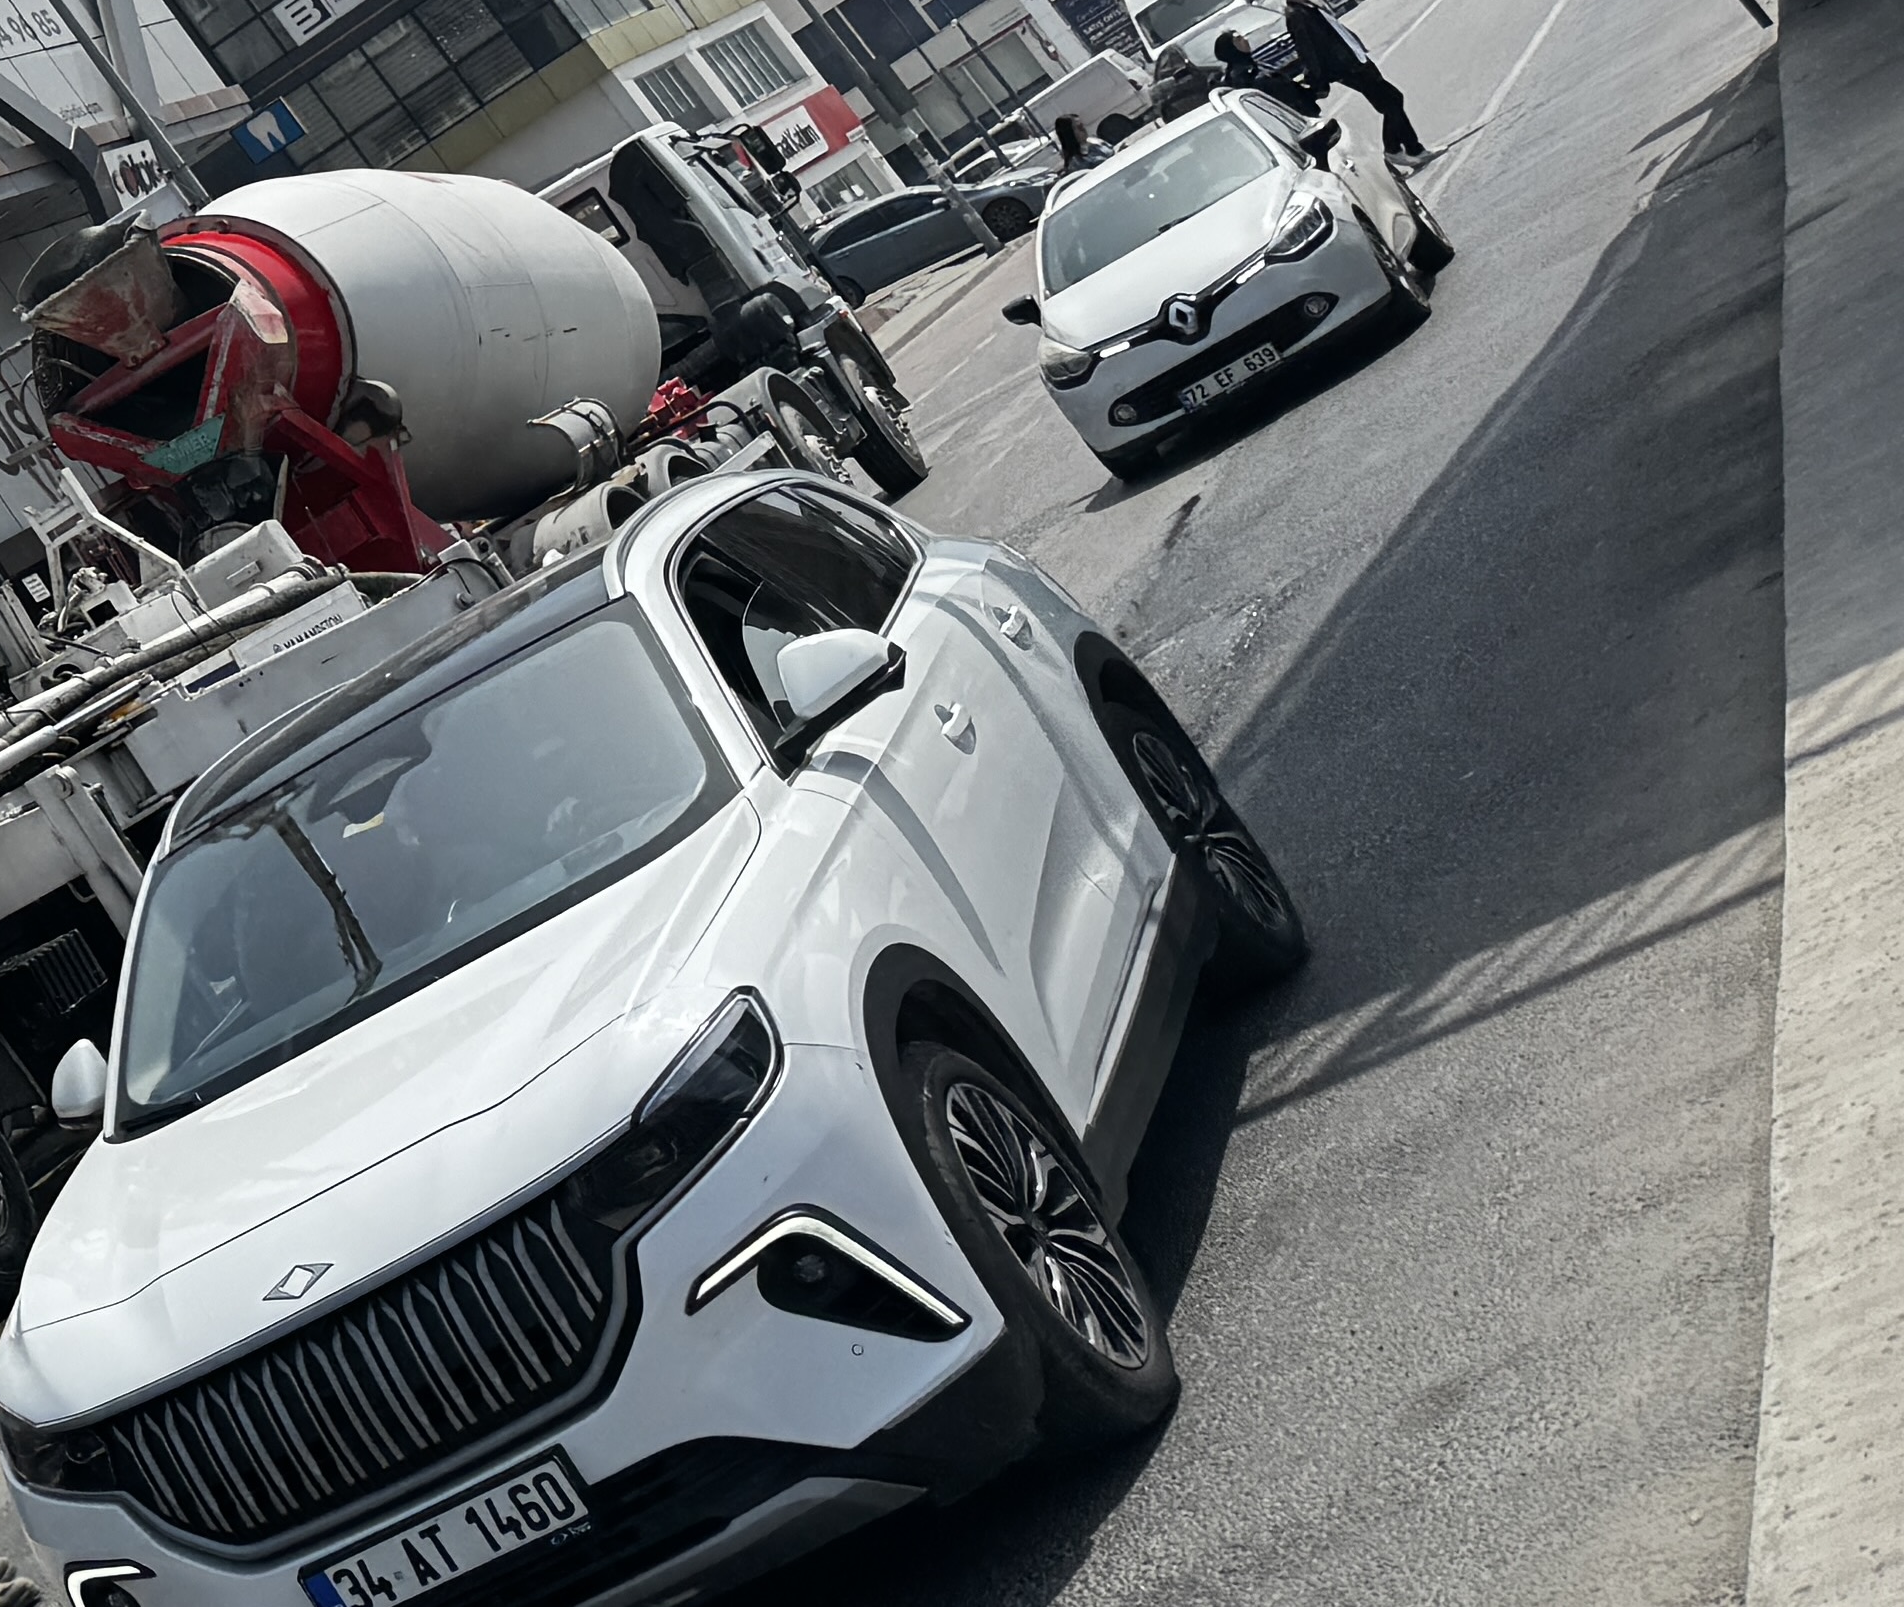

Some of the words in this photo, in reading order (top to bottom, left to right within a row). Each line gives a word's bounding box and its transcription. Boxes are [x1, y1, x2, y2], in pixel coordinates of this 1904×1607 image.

[31, 9, 62, 37] 85
[1183, 383, 1209, 403] 72
[1213, 367, 1234, 388] EF
[1243, 347, 1276, 371] 639
[332, 1559, 397, 1607] 34
[401, 1523, 459, 1587] AT
[465, 1472, 576, 1552] 1460
